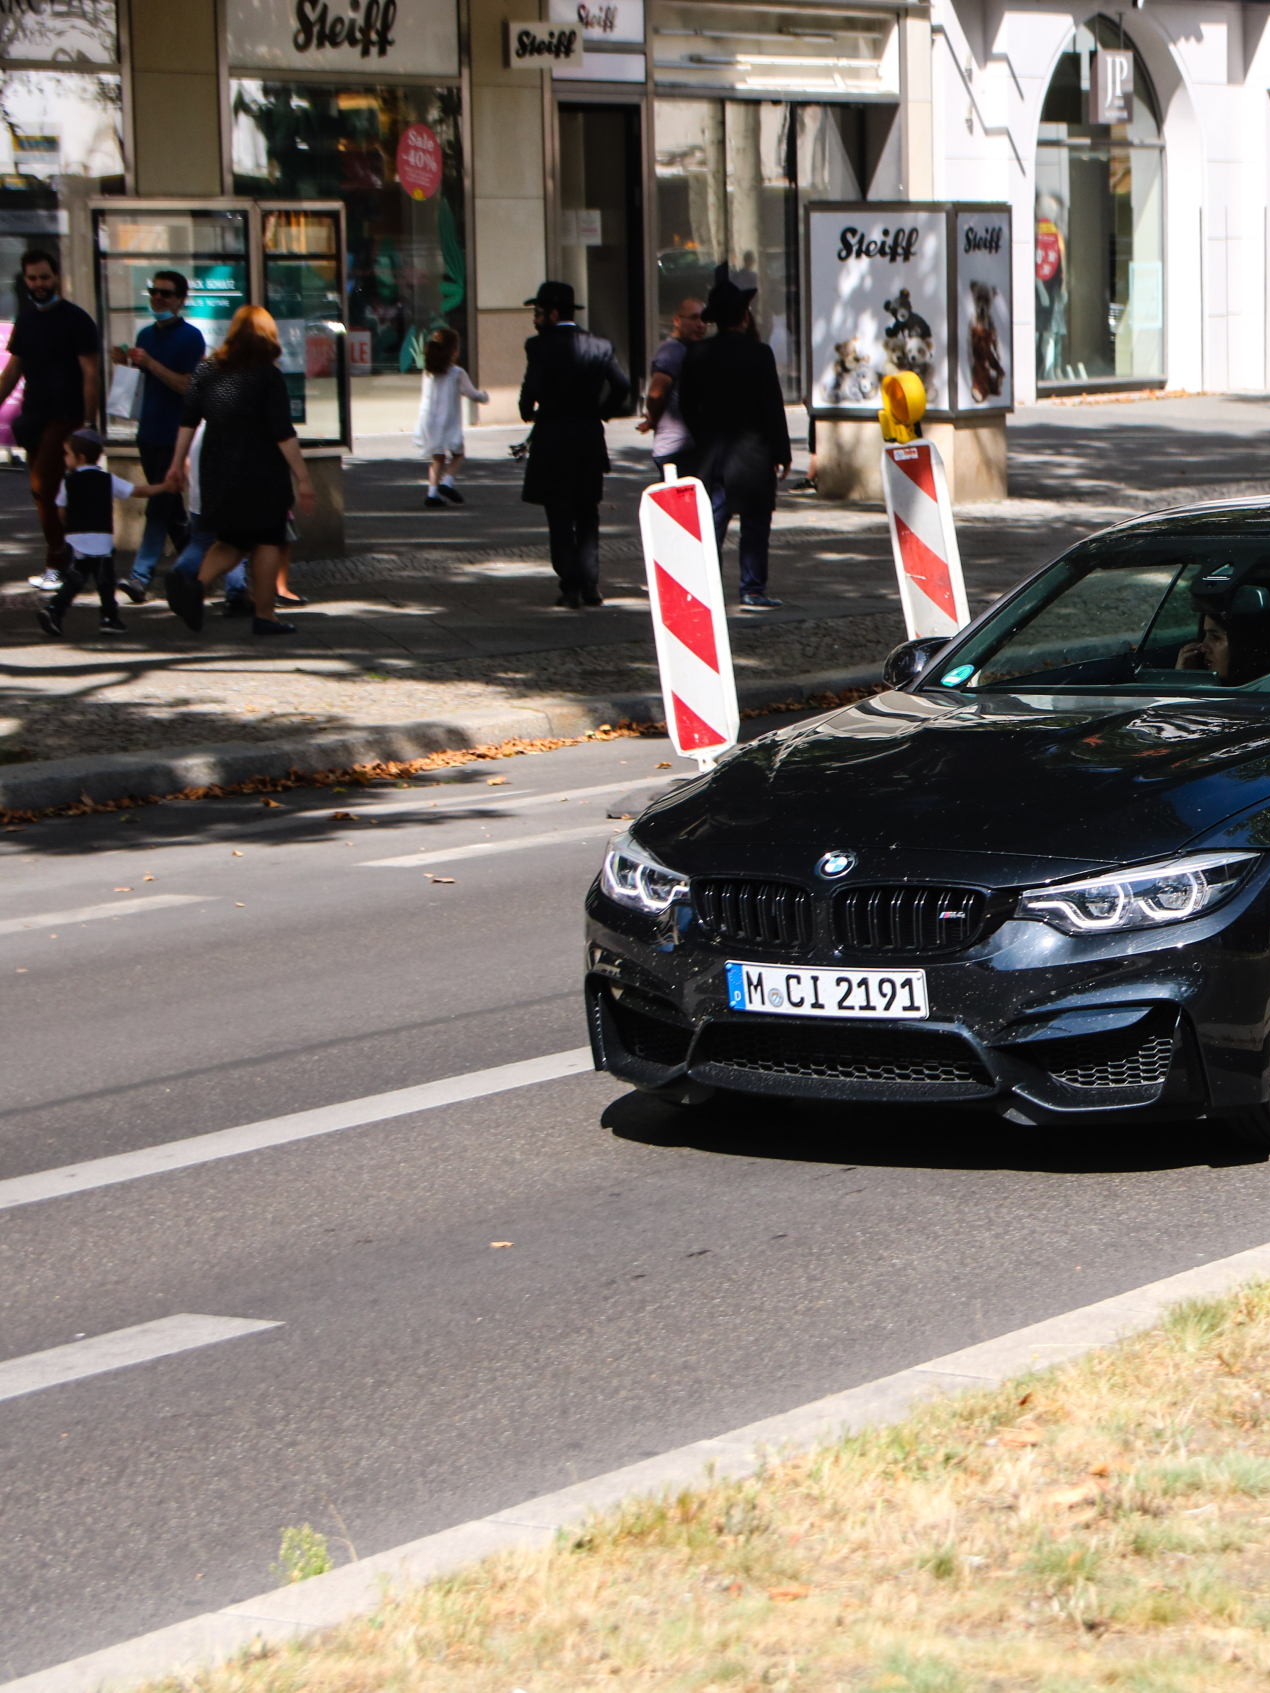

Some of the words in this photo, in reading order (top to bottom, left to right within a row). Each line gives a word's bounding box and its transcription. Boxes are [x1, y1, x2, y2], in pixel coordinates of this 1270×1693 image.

[293, 0, 397, 59] Steiff
[577, 4, 618, 33] Steiff
[516, 29, 577, 59] Steiff
[408, 129, 434, 152] Sale
[837, 226, 919, 263] Steiff
[964, 226, 1002, 255] Steiff
[746, 970, 765, 1006] M
[785, 974, 825, 1009] CI
[836, 976, 921, 1012] 2191
